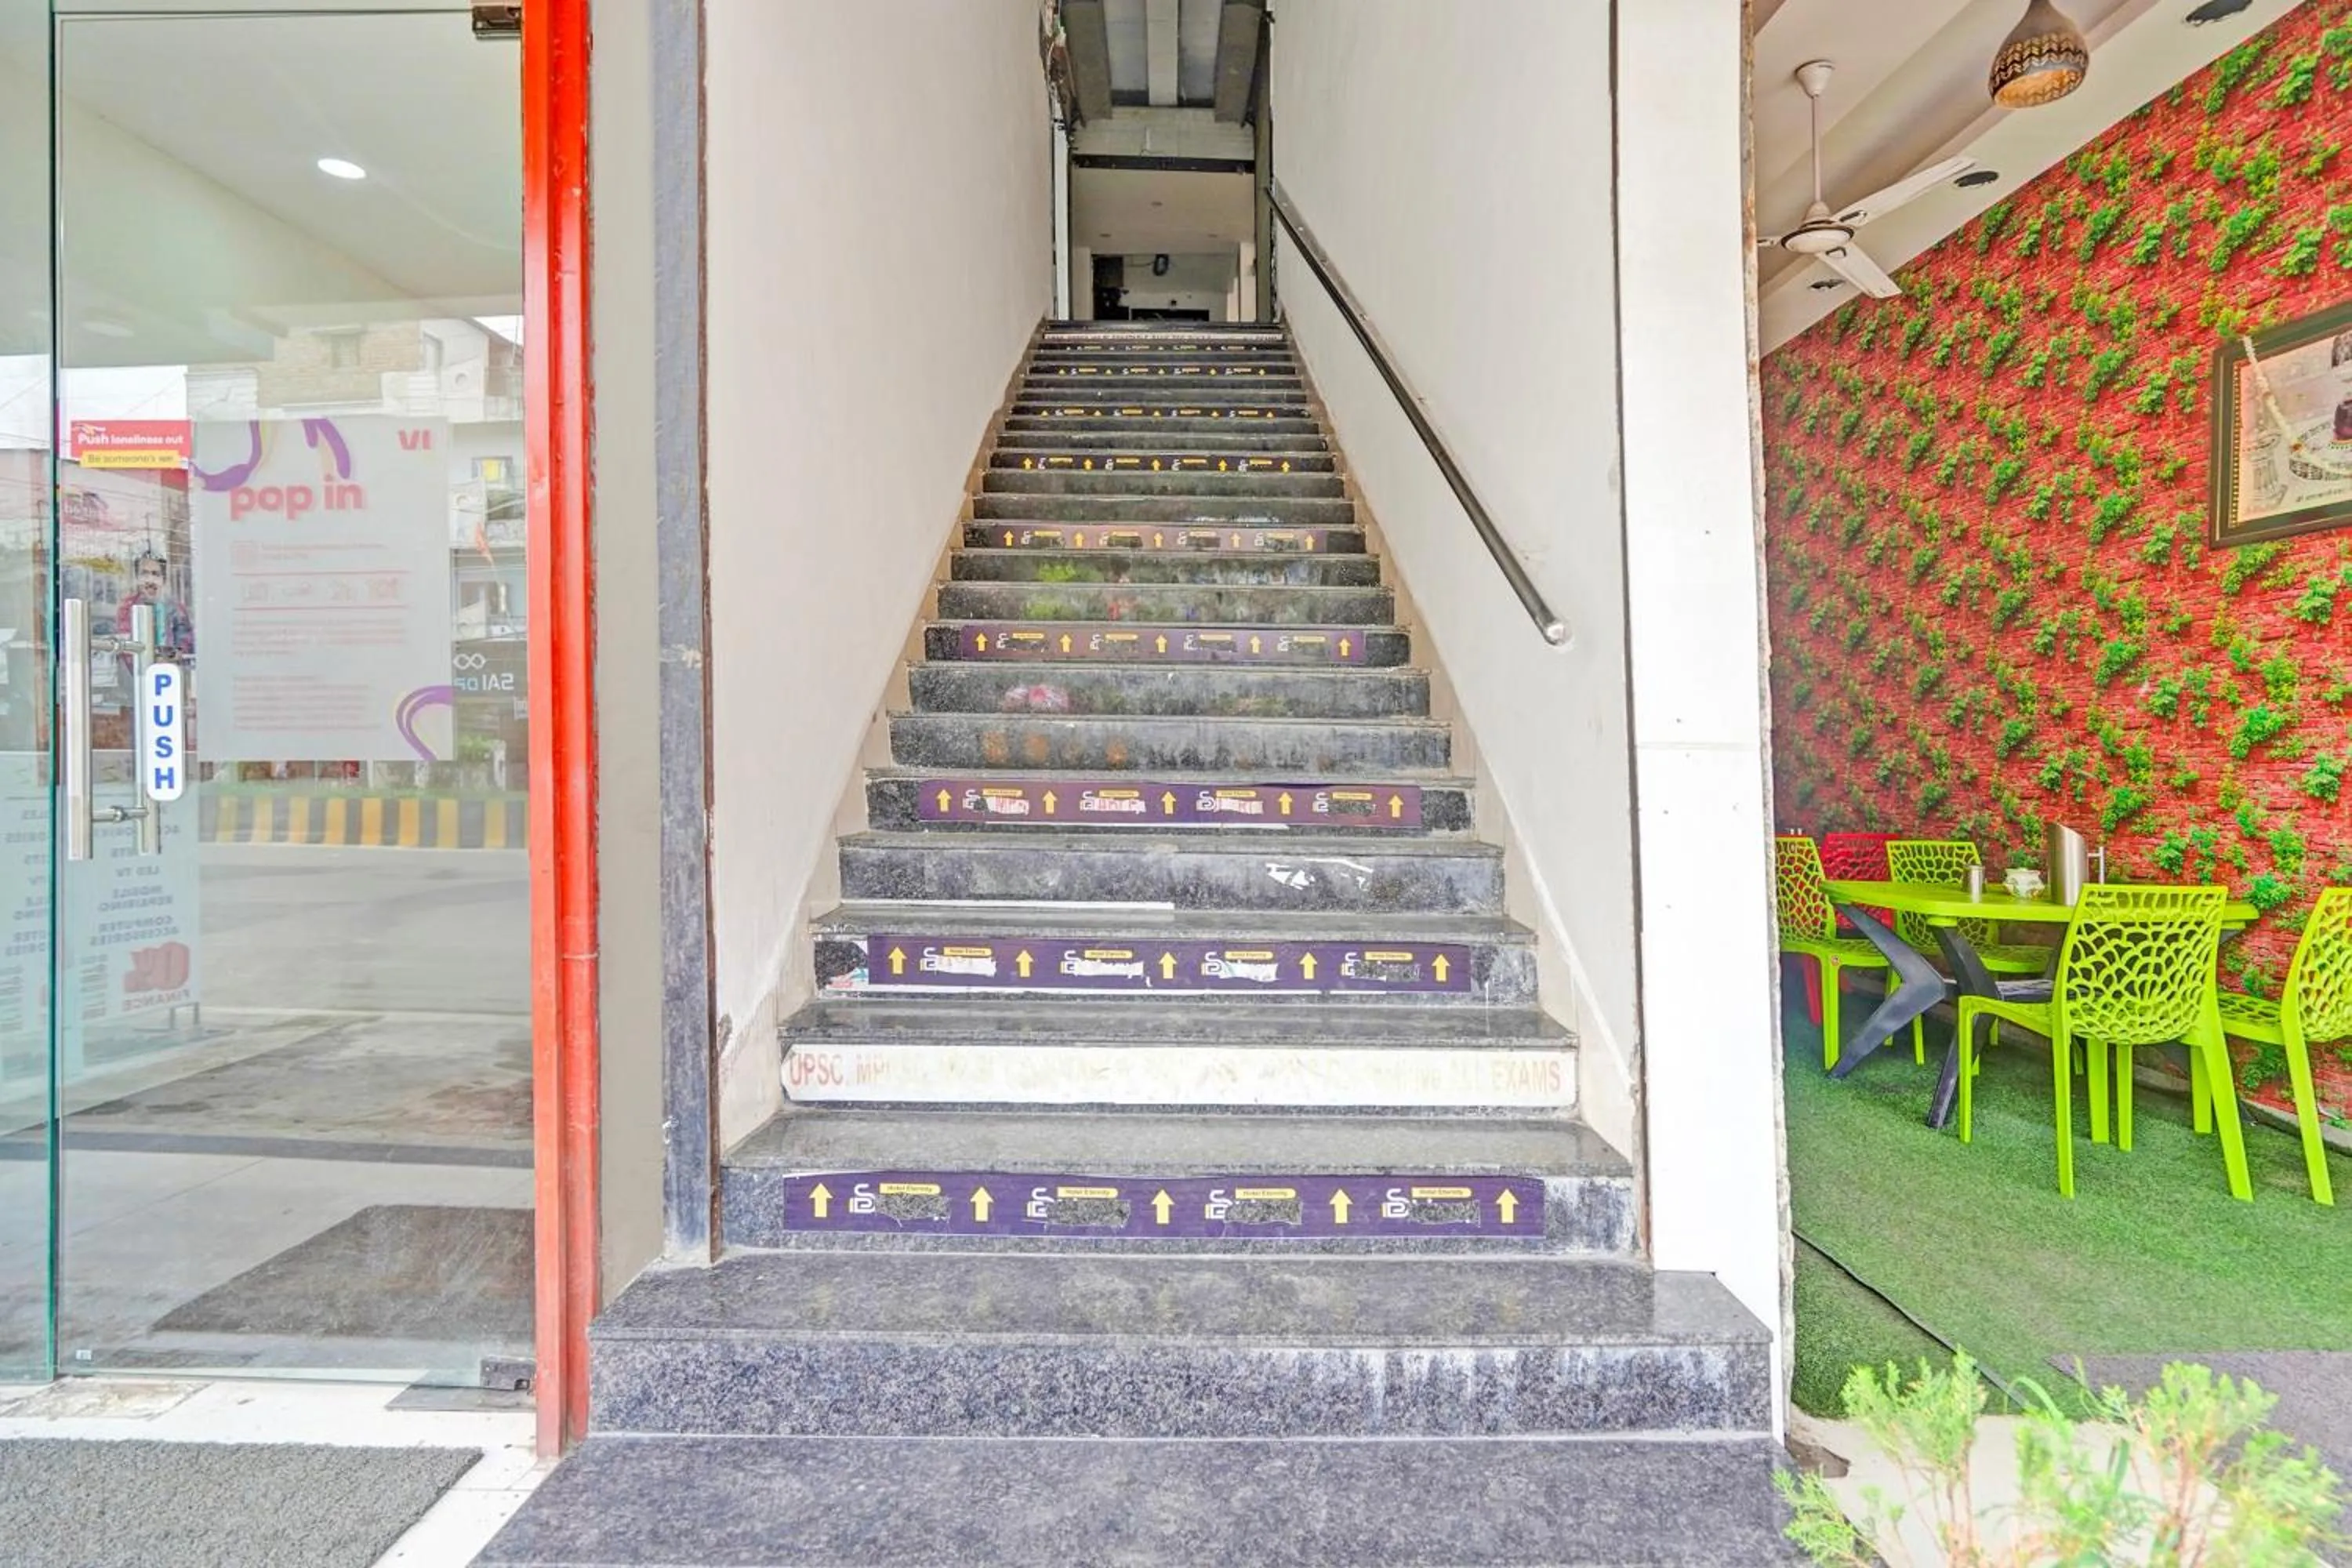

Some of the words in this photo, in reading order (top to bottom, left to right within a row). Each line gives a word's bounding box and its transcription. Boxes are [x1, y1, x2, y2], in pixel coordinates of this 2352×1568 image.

[78, 433, 108, 445] Push
[111, 434, 163, 445] loneliness
[165, 434, 184, 445] out
[230, 485, 313, 521] pop
[324, 473, 364, 510] in
[154, 673, 174, 789] PUSH
[1491, 1059, 1561, 1093] EXAMS
